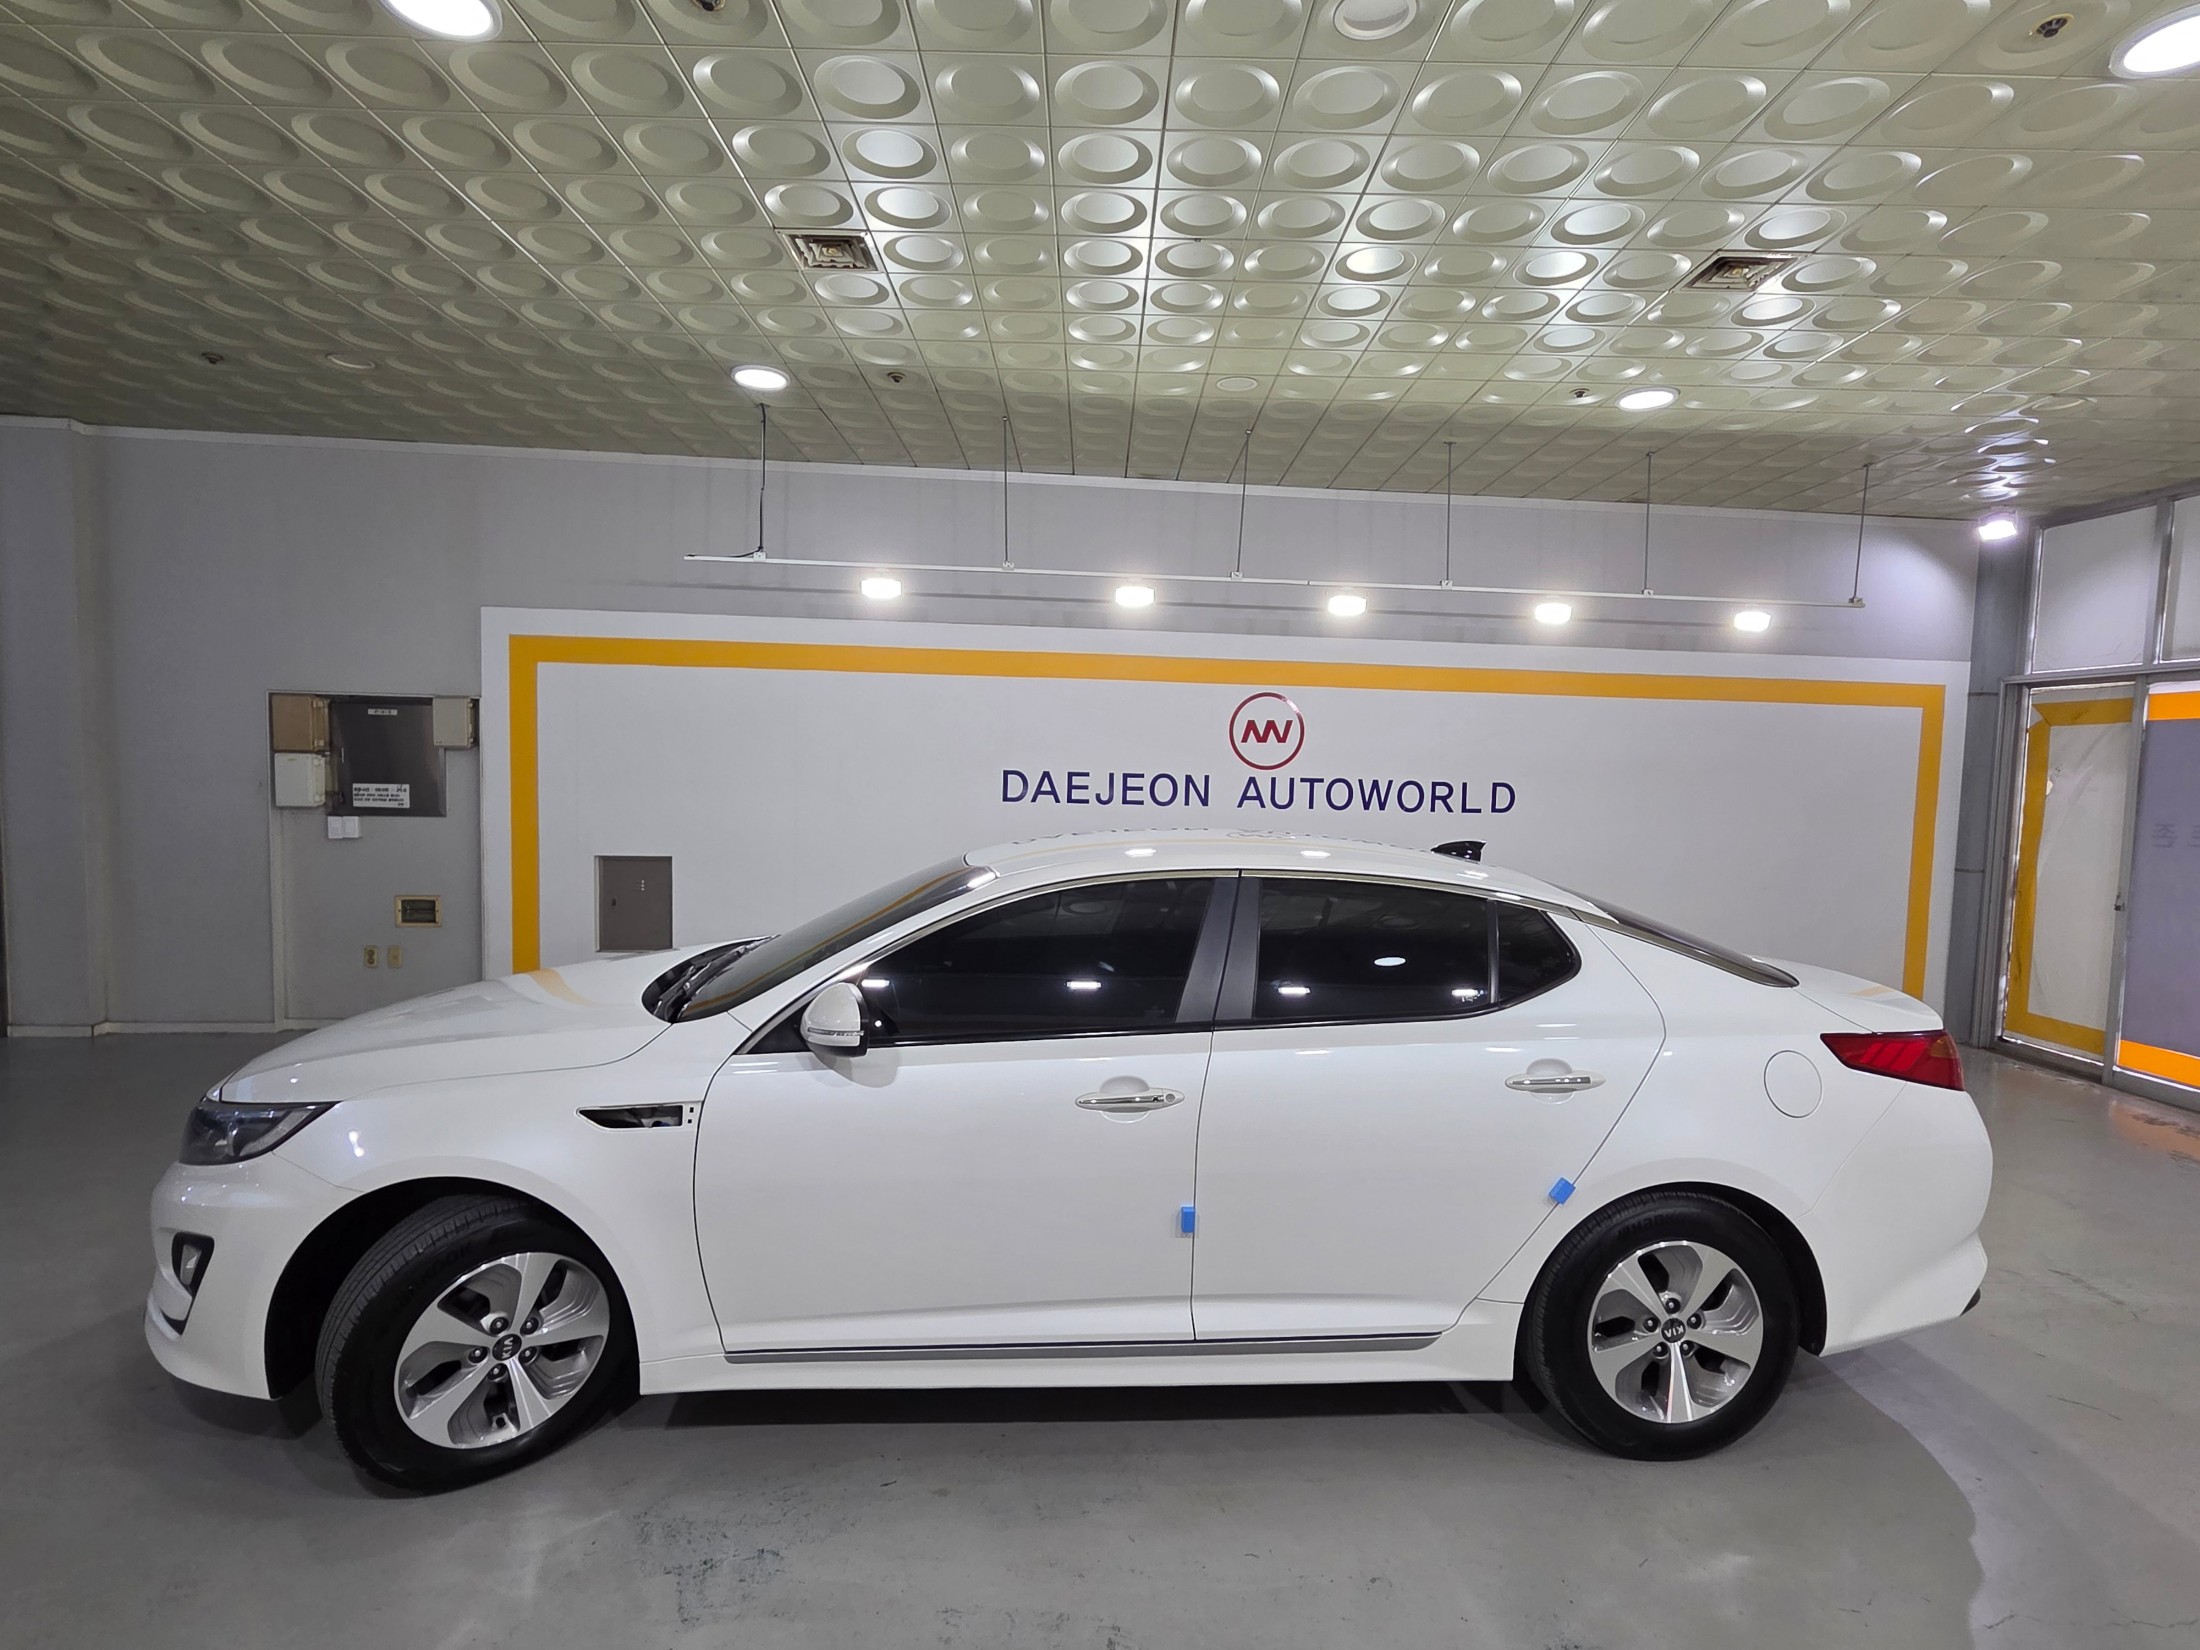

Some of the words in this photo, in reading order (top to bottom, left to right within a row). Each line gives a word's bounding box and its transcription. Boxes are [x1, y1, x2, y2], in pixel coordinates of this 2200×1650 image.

[1002, 769, 1210, 807] DAEJEON
[1236, 776, 1516, 814] AUTOWORLD
[1663, 1325, 1684, 1338] KIA
[501, 1336, 514, 1359] KIA
